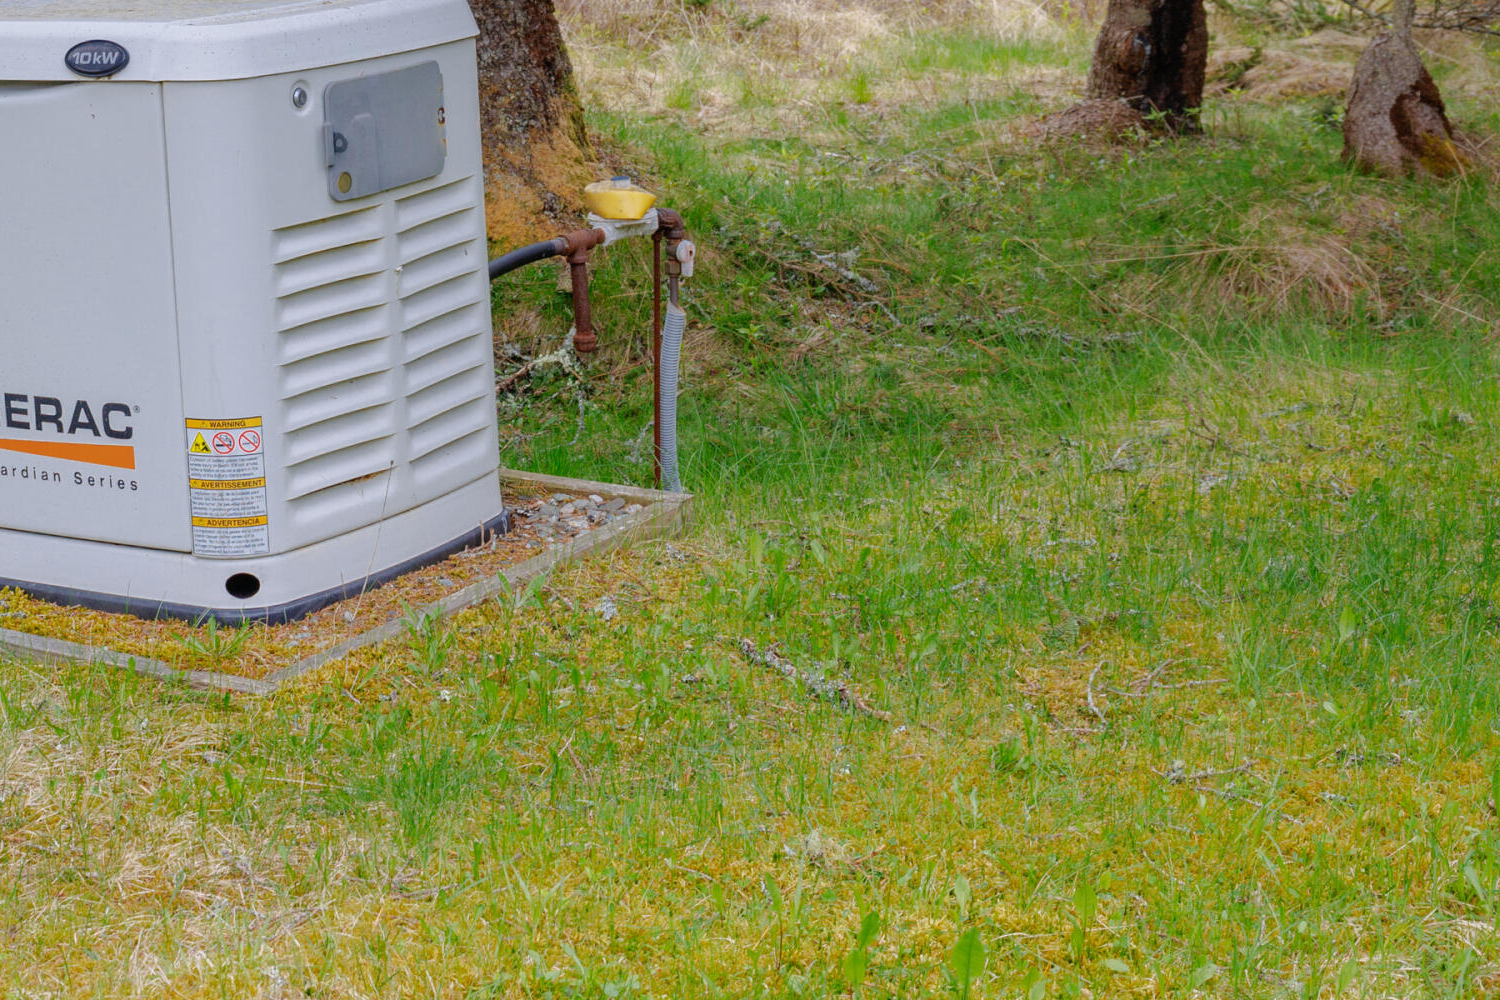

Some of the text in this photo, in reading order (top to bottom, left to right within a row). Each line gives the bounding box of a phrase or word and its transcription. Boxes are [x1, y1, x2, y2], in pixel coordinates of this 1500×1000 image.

[72, 51, 120, 65] 10kW
[209, 420, 247, 428] WARNING
[73, 471, 138, 491] Series
[201, 480, 263, 488] AVERTISSEMENT
[207, 518, 260, 526] ADVERTENCIA
